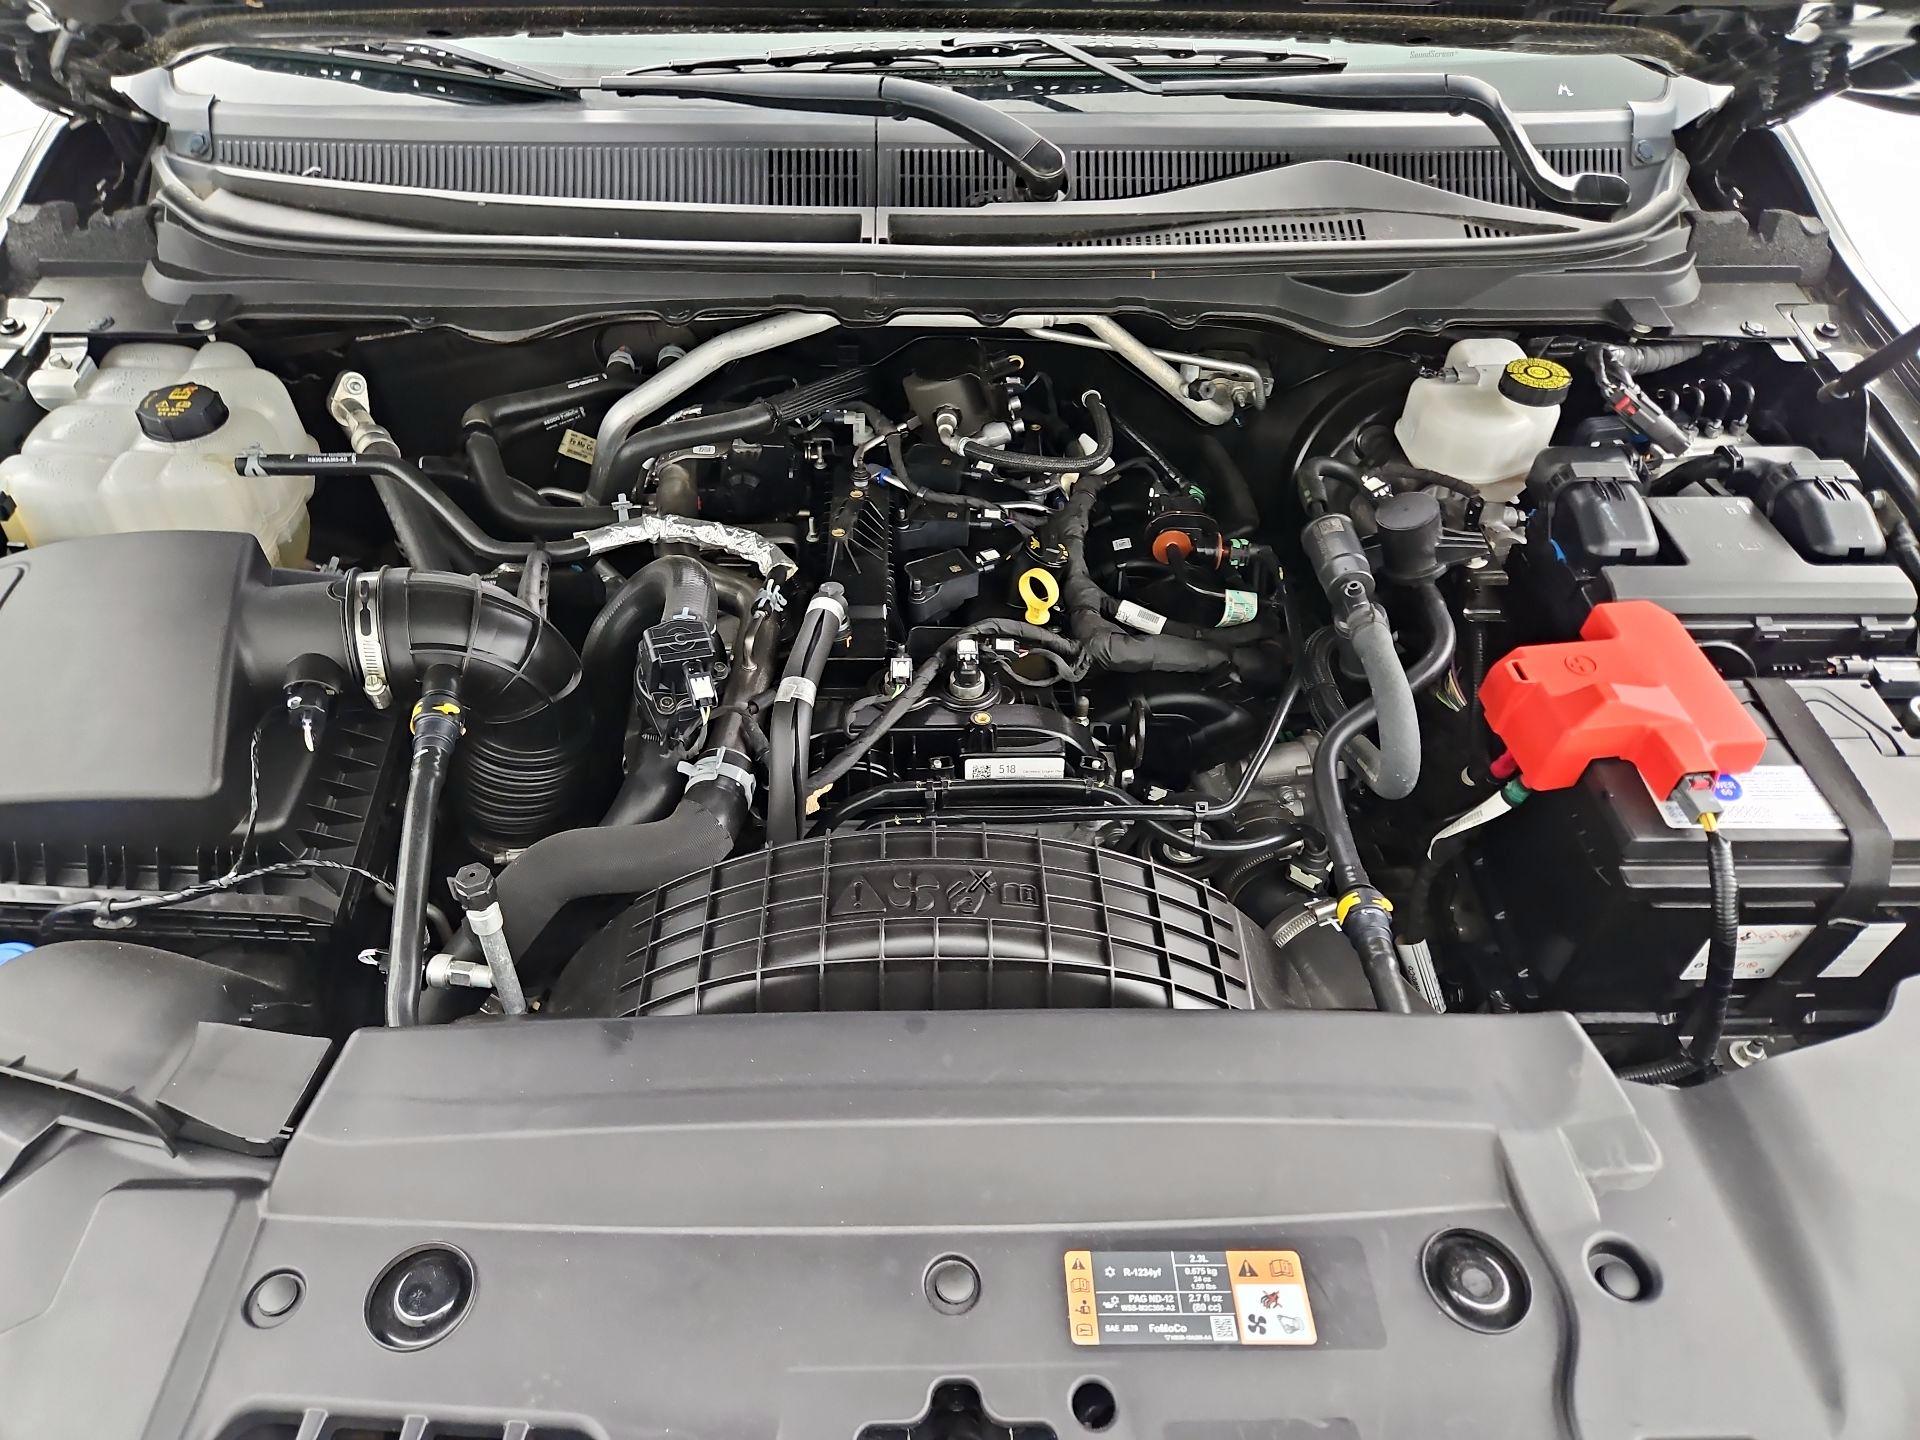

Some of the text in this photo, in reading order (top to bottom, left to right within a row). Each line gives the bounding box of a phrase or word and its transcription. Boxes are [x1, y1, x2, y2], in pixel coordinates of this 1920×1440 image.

[999, 765, 1016, 774] 518
[1123, 1267, 1162, 1278] R-1234yf
[1207, 1267, 1218, 1277] kg
[1128, 1295, 1175, 1303] PAG ND-12
[1188, 1294, 1201, 1303] 2.7
[1211, 1295, 1223, 1303] oz
[1105, 1324, 1121, 1332] SAE
[1148, 1323, 1188, 1333] FoMoCo
